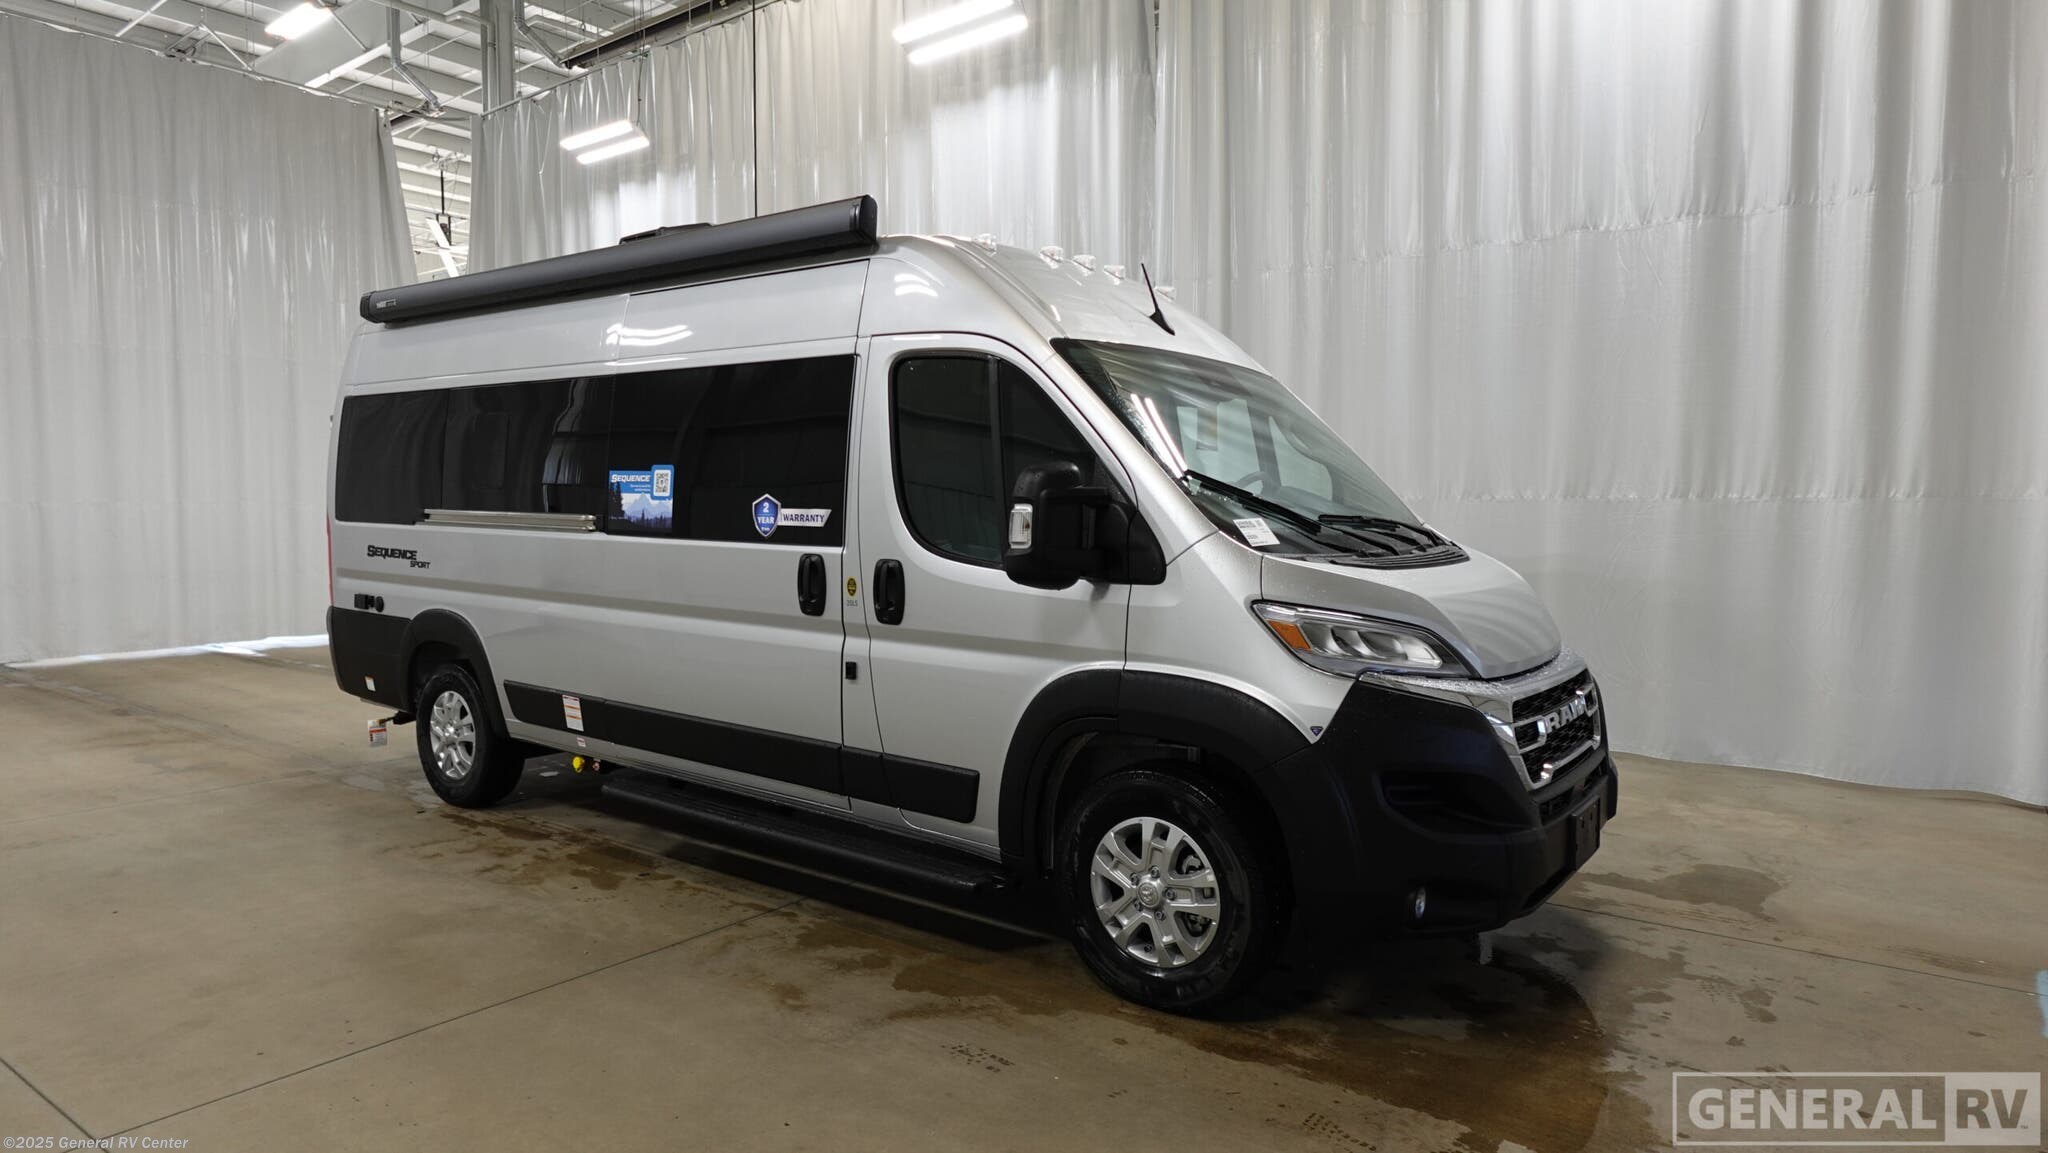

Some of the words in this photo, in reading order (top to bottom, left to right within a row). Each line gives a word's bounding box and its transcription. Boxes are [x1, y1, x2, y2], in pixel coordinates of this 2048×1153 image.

[611, 474, 651, 483] SEQUENCE
[762, 502, 770, 513] 2
[757, 516, 775, 524] YEAR
[783, 513, 825, 523] WARRANTY
[367, 544, 418, 561] SEQUENCE
[409, 560, 431, 569] SPORT
[1544, 696, 1586, 734] RAM
